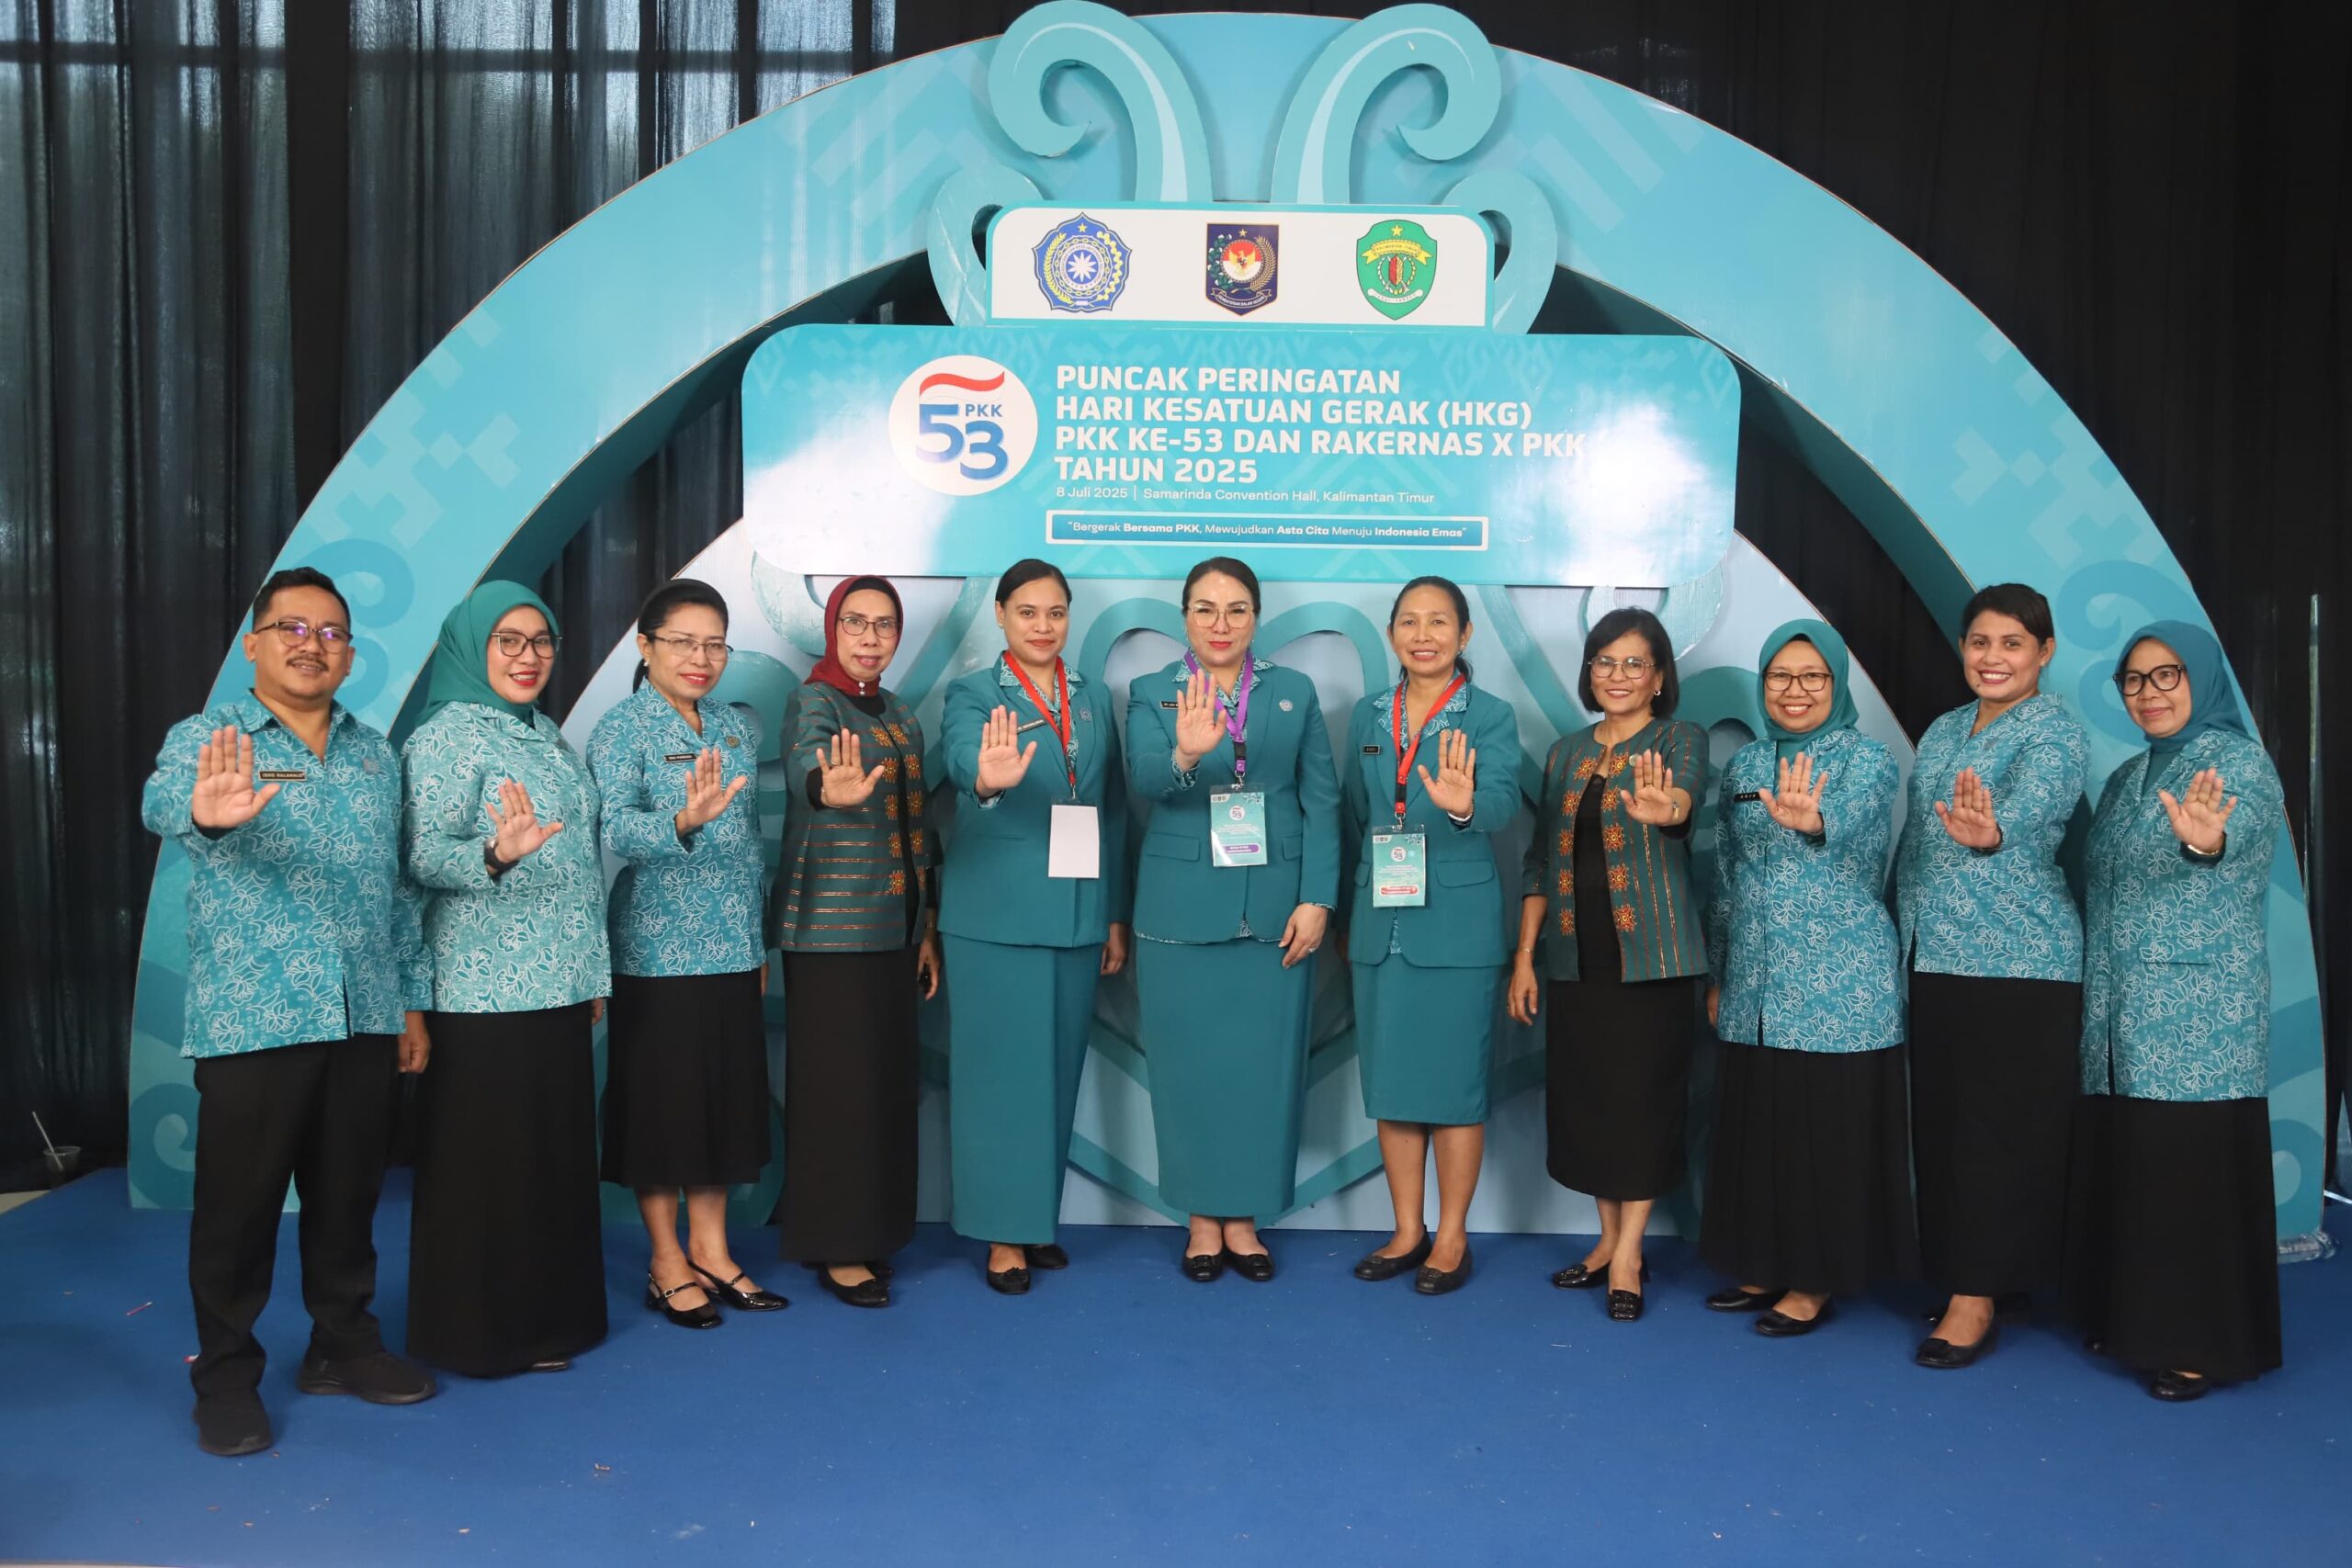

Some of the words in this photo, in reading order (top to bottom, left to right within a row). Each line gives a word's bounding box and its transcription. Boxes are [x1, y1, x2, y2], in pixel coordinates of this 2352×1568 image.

[1057, 365, 1189, 391] PUNCAK
[1197, 367, 1401, 394] PERINGATAN
[965, 403, 1003, 418] PKK
[1056, 395, 1133, 421] HARI
[1143, 396, 1312, 423] KESATUAN
[1321, 400, 1430, 425] GERAK
[1437, 400, 1532, 430] (HKG)
[915, 403, 1009, 481] 53
[1056, 425, 1119, 450] PKK
[1128, 427, 1223, 453] KE-53
[1233, 429, 1300, 454] DAN
[1311, 430, 1483, 457] RAKERNAS
[1491, 432, 1514, 457] X
[1522, 433, 1588, 458] PKK
[1054, 456, 1164, 481] TAHUN
[1174, 457, 1258, 484] 2025
[1056, 487, 1066, 498] 8
[1068, 487, 1091, 499] Juli
[1093, 487, 1128, 499] 2025
[1142, 489, 1213, 501] Samarinda
[1215, 490, 1288, 502] Convention
[1292, 491, 1320, 503] Hall,
[1322, 491, 1395, 503] Kalimantan
[1397, 491, 1436, 503] Timur
[1123, 522, 1173, 534] Bersama
[1175, 523, 1203, 535] PKK,
[1204, 524, 1274, 536] Mewujudkan
[1276, 525, 1303, 536] Asta
[1305, 525, 1330, 536] Cita
[1331, 525, 1374, 538] Menuju
[1374, 526, 1430, 537] Indonesia
